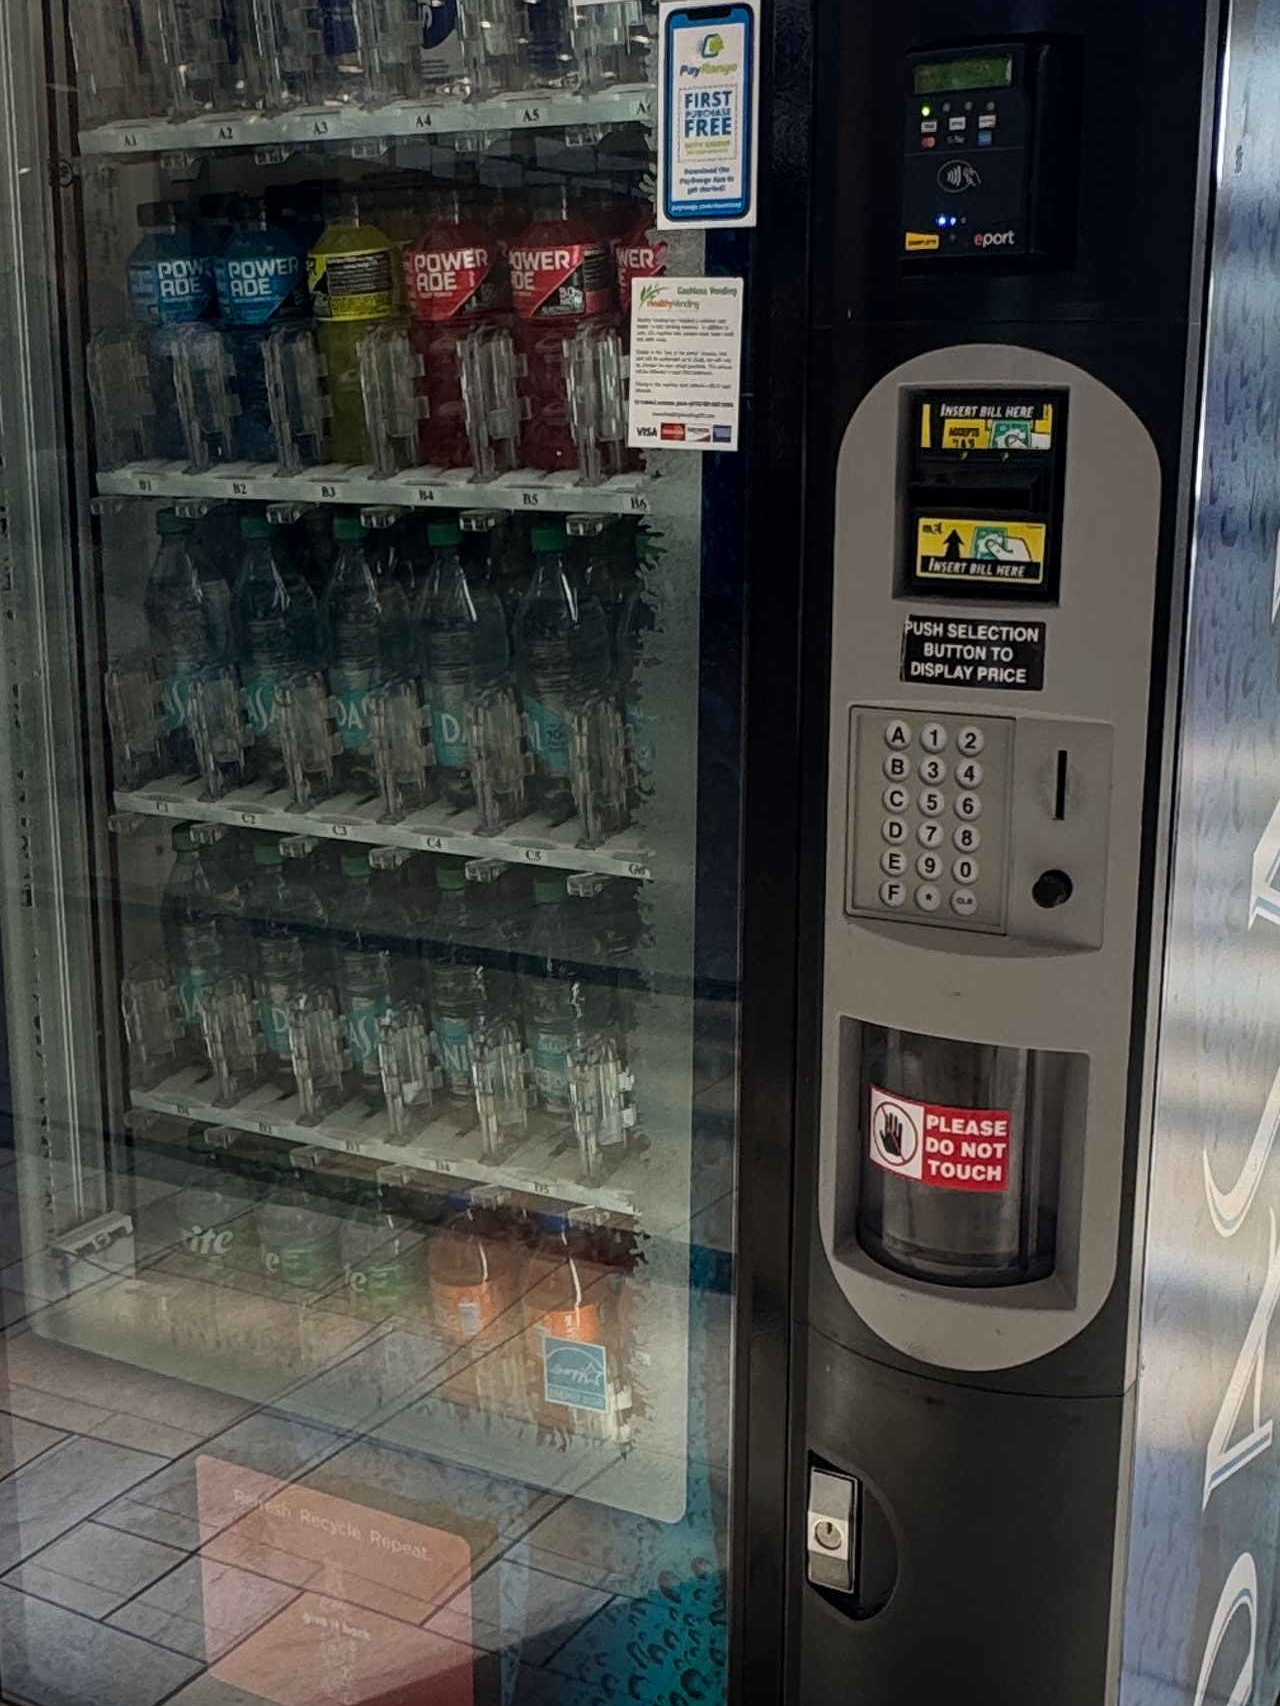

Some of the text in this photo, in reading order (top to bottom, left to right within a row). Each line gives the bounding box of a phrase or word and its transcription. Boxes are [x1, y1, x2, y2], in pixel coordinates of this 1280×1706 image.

[680, 63, 738, 79] PayRange
[684, 91, 733, 110] FIRST
[416, 114, 431, 128] A4
[523, 108, 540, 122] A5
[685, 107, 731, 119] PURCHASE
[219, 127, 233, 140] A2
[313, 121, 328, 134] A3
[684, 116, 732, 139] FREE
[124, 134, 136, 146] A1
[974, 230, 1015, 248] eport
[228, 256, 299, 279] POWER
[414, 248, 488, 274] POWER
[509, 249, 570, 271] OWER
[160, 277, 203, 298] ADE
[230, 278, 272, 297] ADE
[416, 272, 457, 292] ADE
[636, 427, 658, 437] VISA
[523, 493, 539, 505] B5
[905, 619, 1038, 642] PUSH SELECTION
[923, 642, 1013, 662] BUTTON TO
[910, 661, 1026, 683] DISPLAY PRICE
[892, 726, 906, 744] A
[929, 729, 938, 746] 1
[965, 733, 976, 749] 2
[891, 758, 904, 775] B
[928, 762, 938, 778] 3
[963, 766, 974, 781] 4
[890, 790, 903, 806] C
[927, 794, 937, 810] 5
[963, 797, 974, 814] 6
[889, 822, 902, 838] D
[926, 826, 937, 841] 7
[962, 830, 972, 846] 8
[427, 837, 441, 849] C4
[889, 853, 901, 870] E
[925, 858, 935, 873] 9
[960, 862, 971, 878] 0
[888, 885, 900, 900] F
[926, 1114, 1008, 1137] PLEASE
[925, 1137, 1007, 1159] DO NOT
[927, 1159, 1002, 1181] TOUCH
